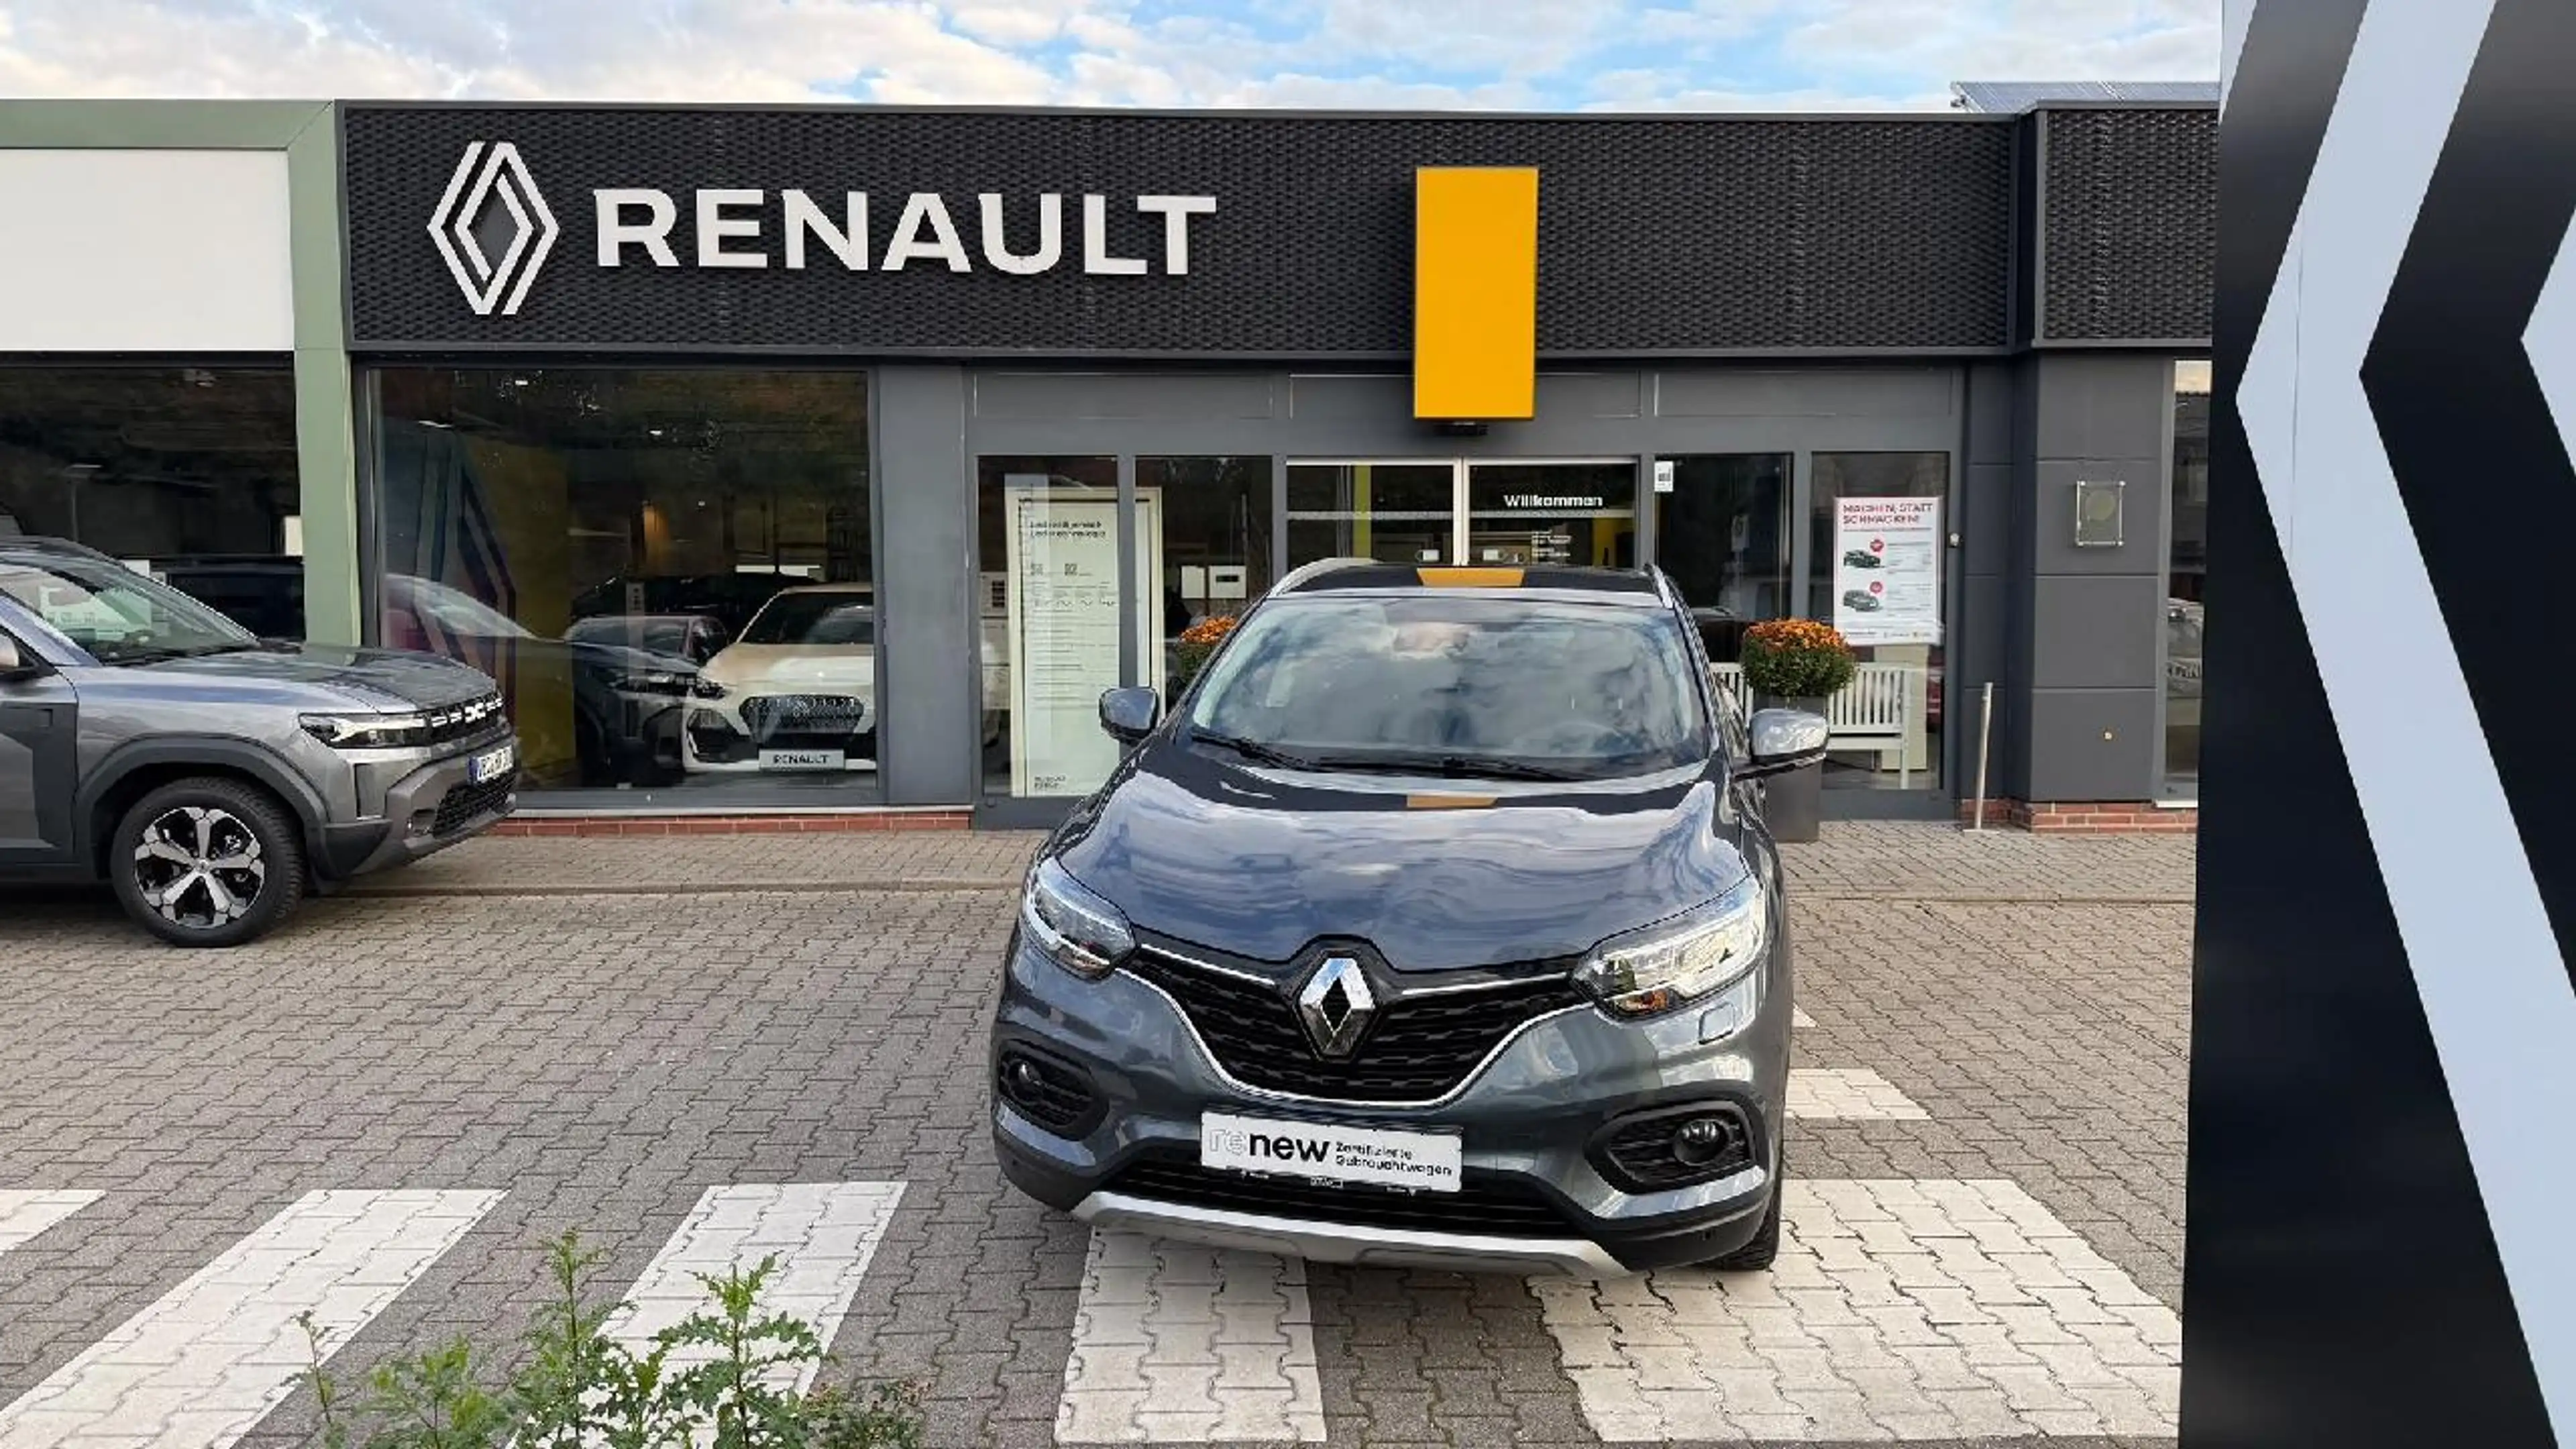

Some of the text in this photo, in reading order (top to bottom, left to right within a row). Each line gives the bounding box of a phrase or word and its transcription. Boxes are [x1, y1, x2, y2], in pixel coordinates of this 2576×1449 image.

[593, 189, 1217, 274] RENAULT
[1503, 494, 1603, 507] Willkommen
[1899, 503, 1933, 513] STATT
[773, 755, 829, 764] RENAULT
[1210, 1129, 1330, 1163] renew
[1336, 1142, 1412, 1160] Zertifizierte
[1336, 1155, 1452, 1176] Gebrauchtwagen
